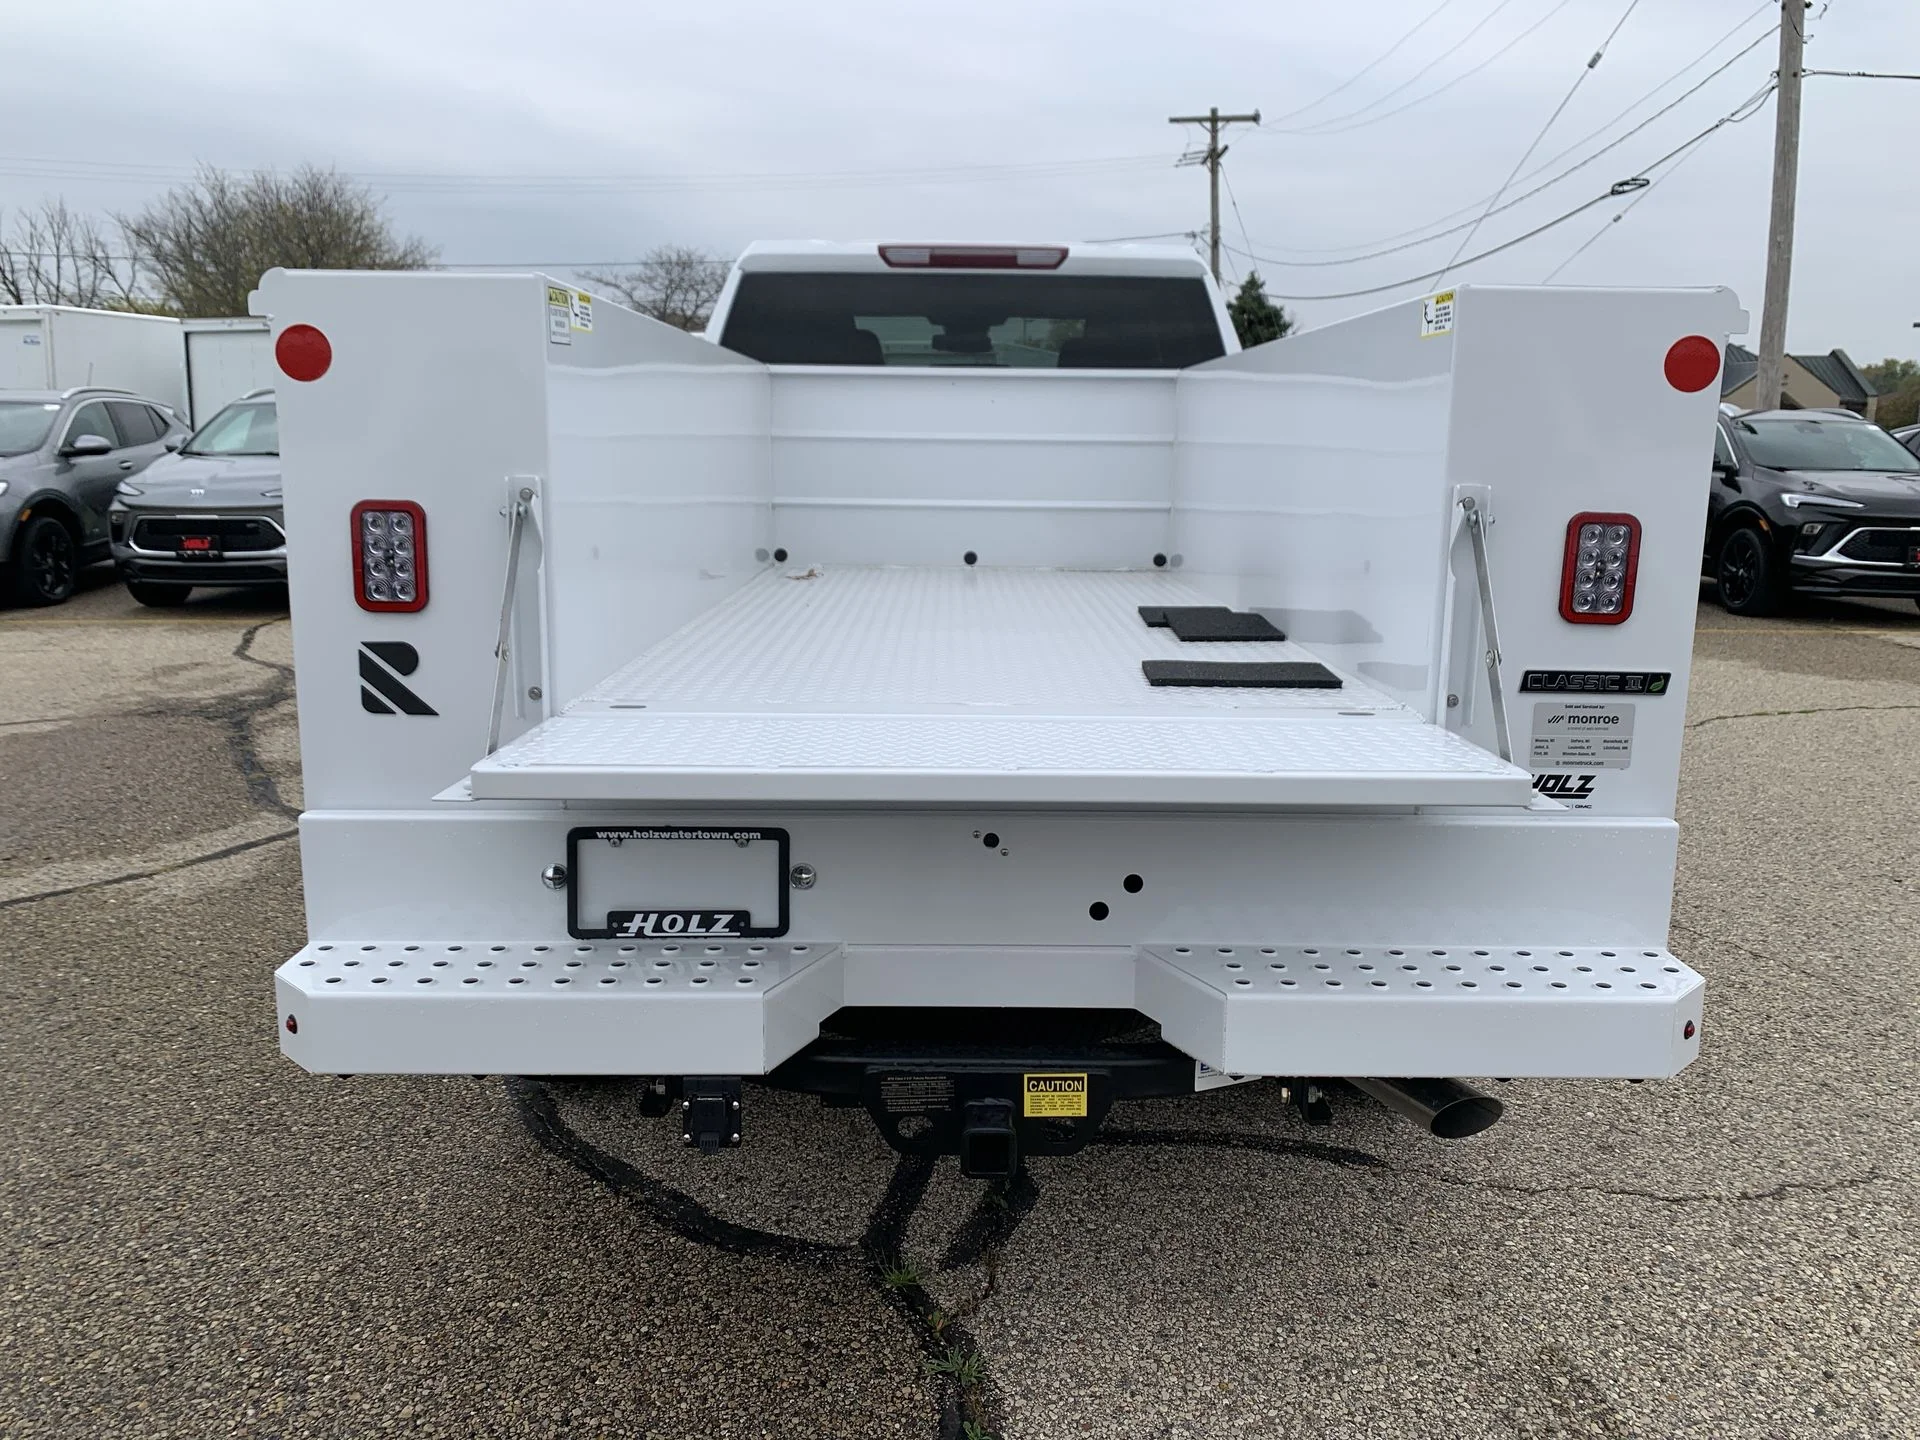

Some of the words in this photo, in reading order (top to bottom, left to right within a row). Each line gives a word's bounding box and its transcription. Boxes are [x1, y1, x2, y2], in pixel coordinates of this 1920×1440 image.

[1527, 673, 1621, 690] CLASSIC
[1567, 715, 1620, 724] monroe
[596, 830, 761, 840] www.holzwatertown.com
[621, 913, 736, 935] HOLZ
[1029, 1080, 1082, 1092] CAUTION
